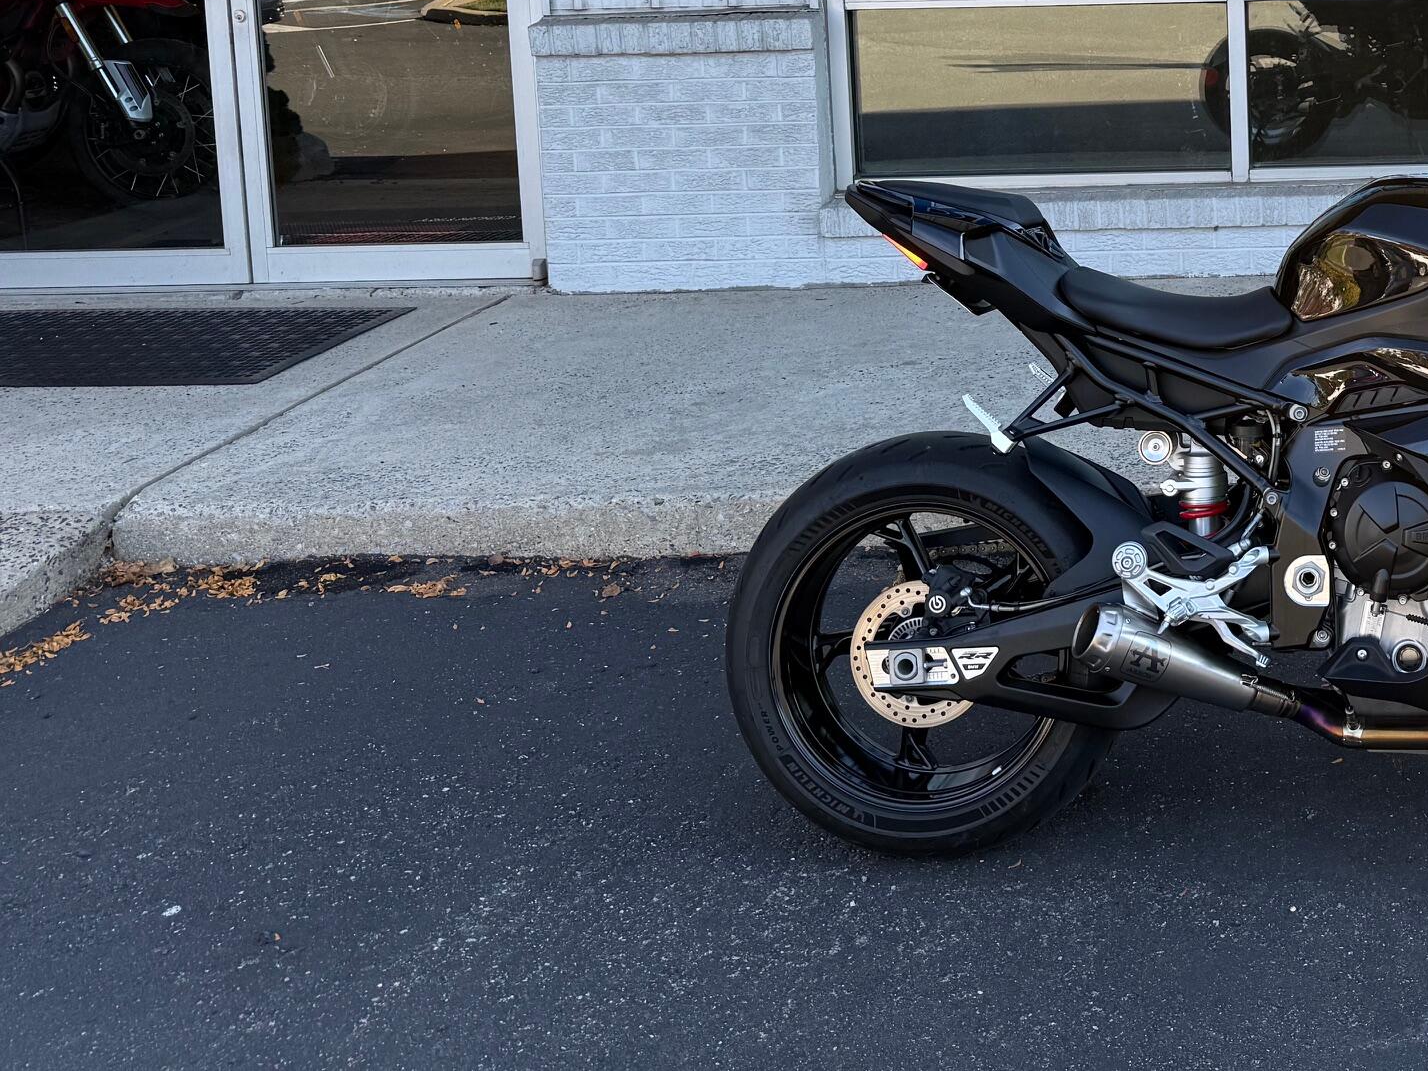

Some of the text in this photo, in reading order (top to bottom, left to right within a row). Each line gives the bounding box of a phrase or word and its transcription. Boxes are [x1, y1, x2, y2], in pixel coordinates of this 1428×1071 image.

[985, 500, 1050, 554] MICHELIN
[760, 710, 852, 816] MICHELIN POWER
